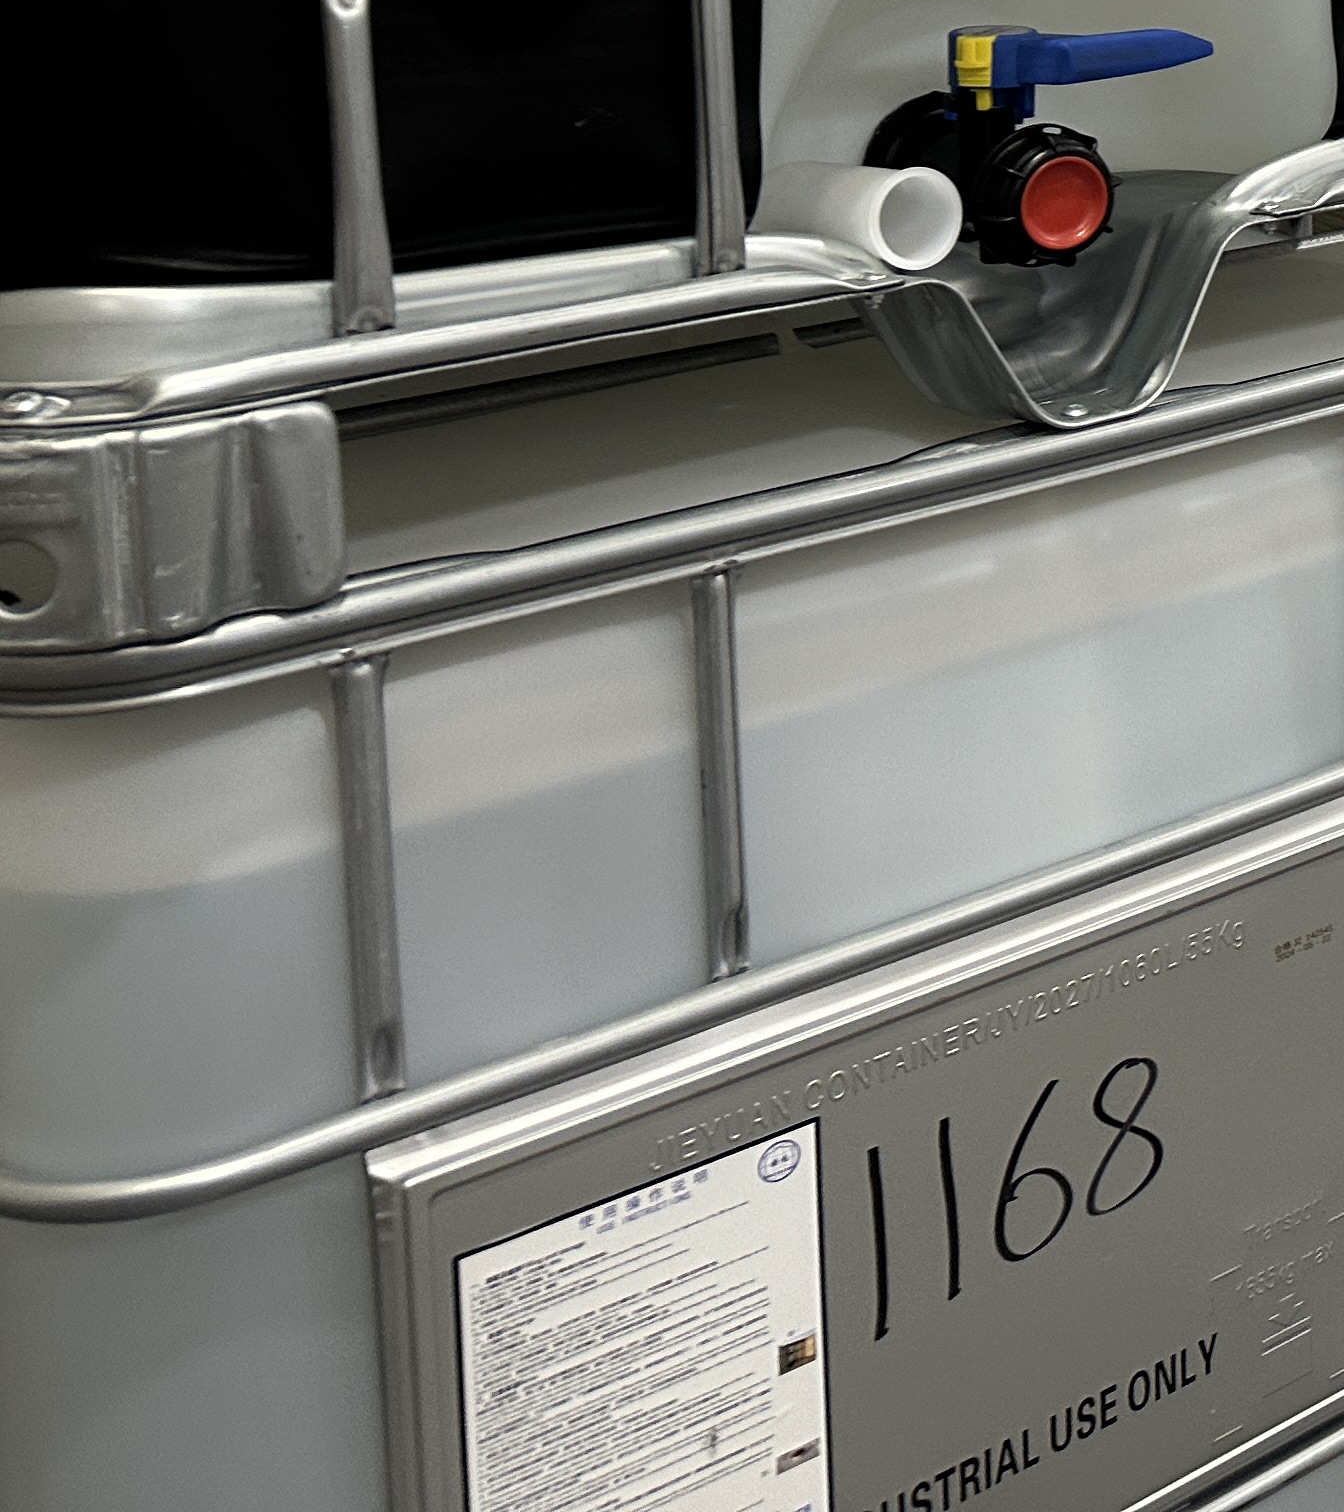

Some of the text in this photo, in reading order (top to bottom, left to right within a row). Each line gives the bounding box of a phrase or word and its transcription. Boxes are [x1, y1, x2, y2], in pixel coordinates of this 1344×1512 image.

[867, 1057, 1165, 1342] 1168
[863, 1331, 1219, 1512] USTRIAL USE ONLY
